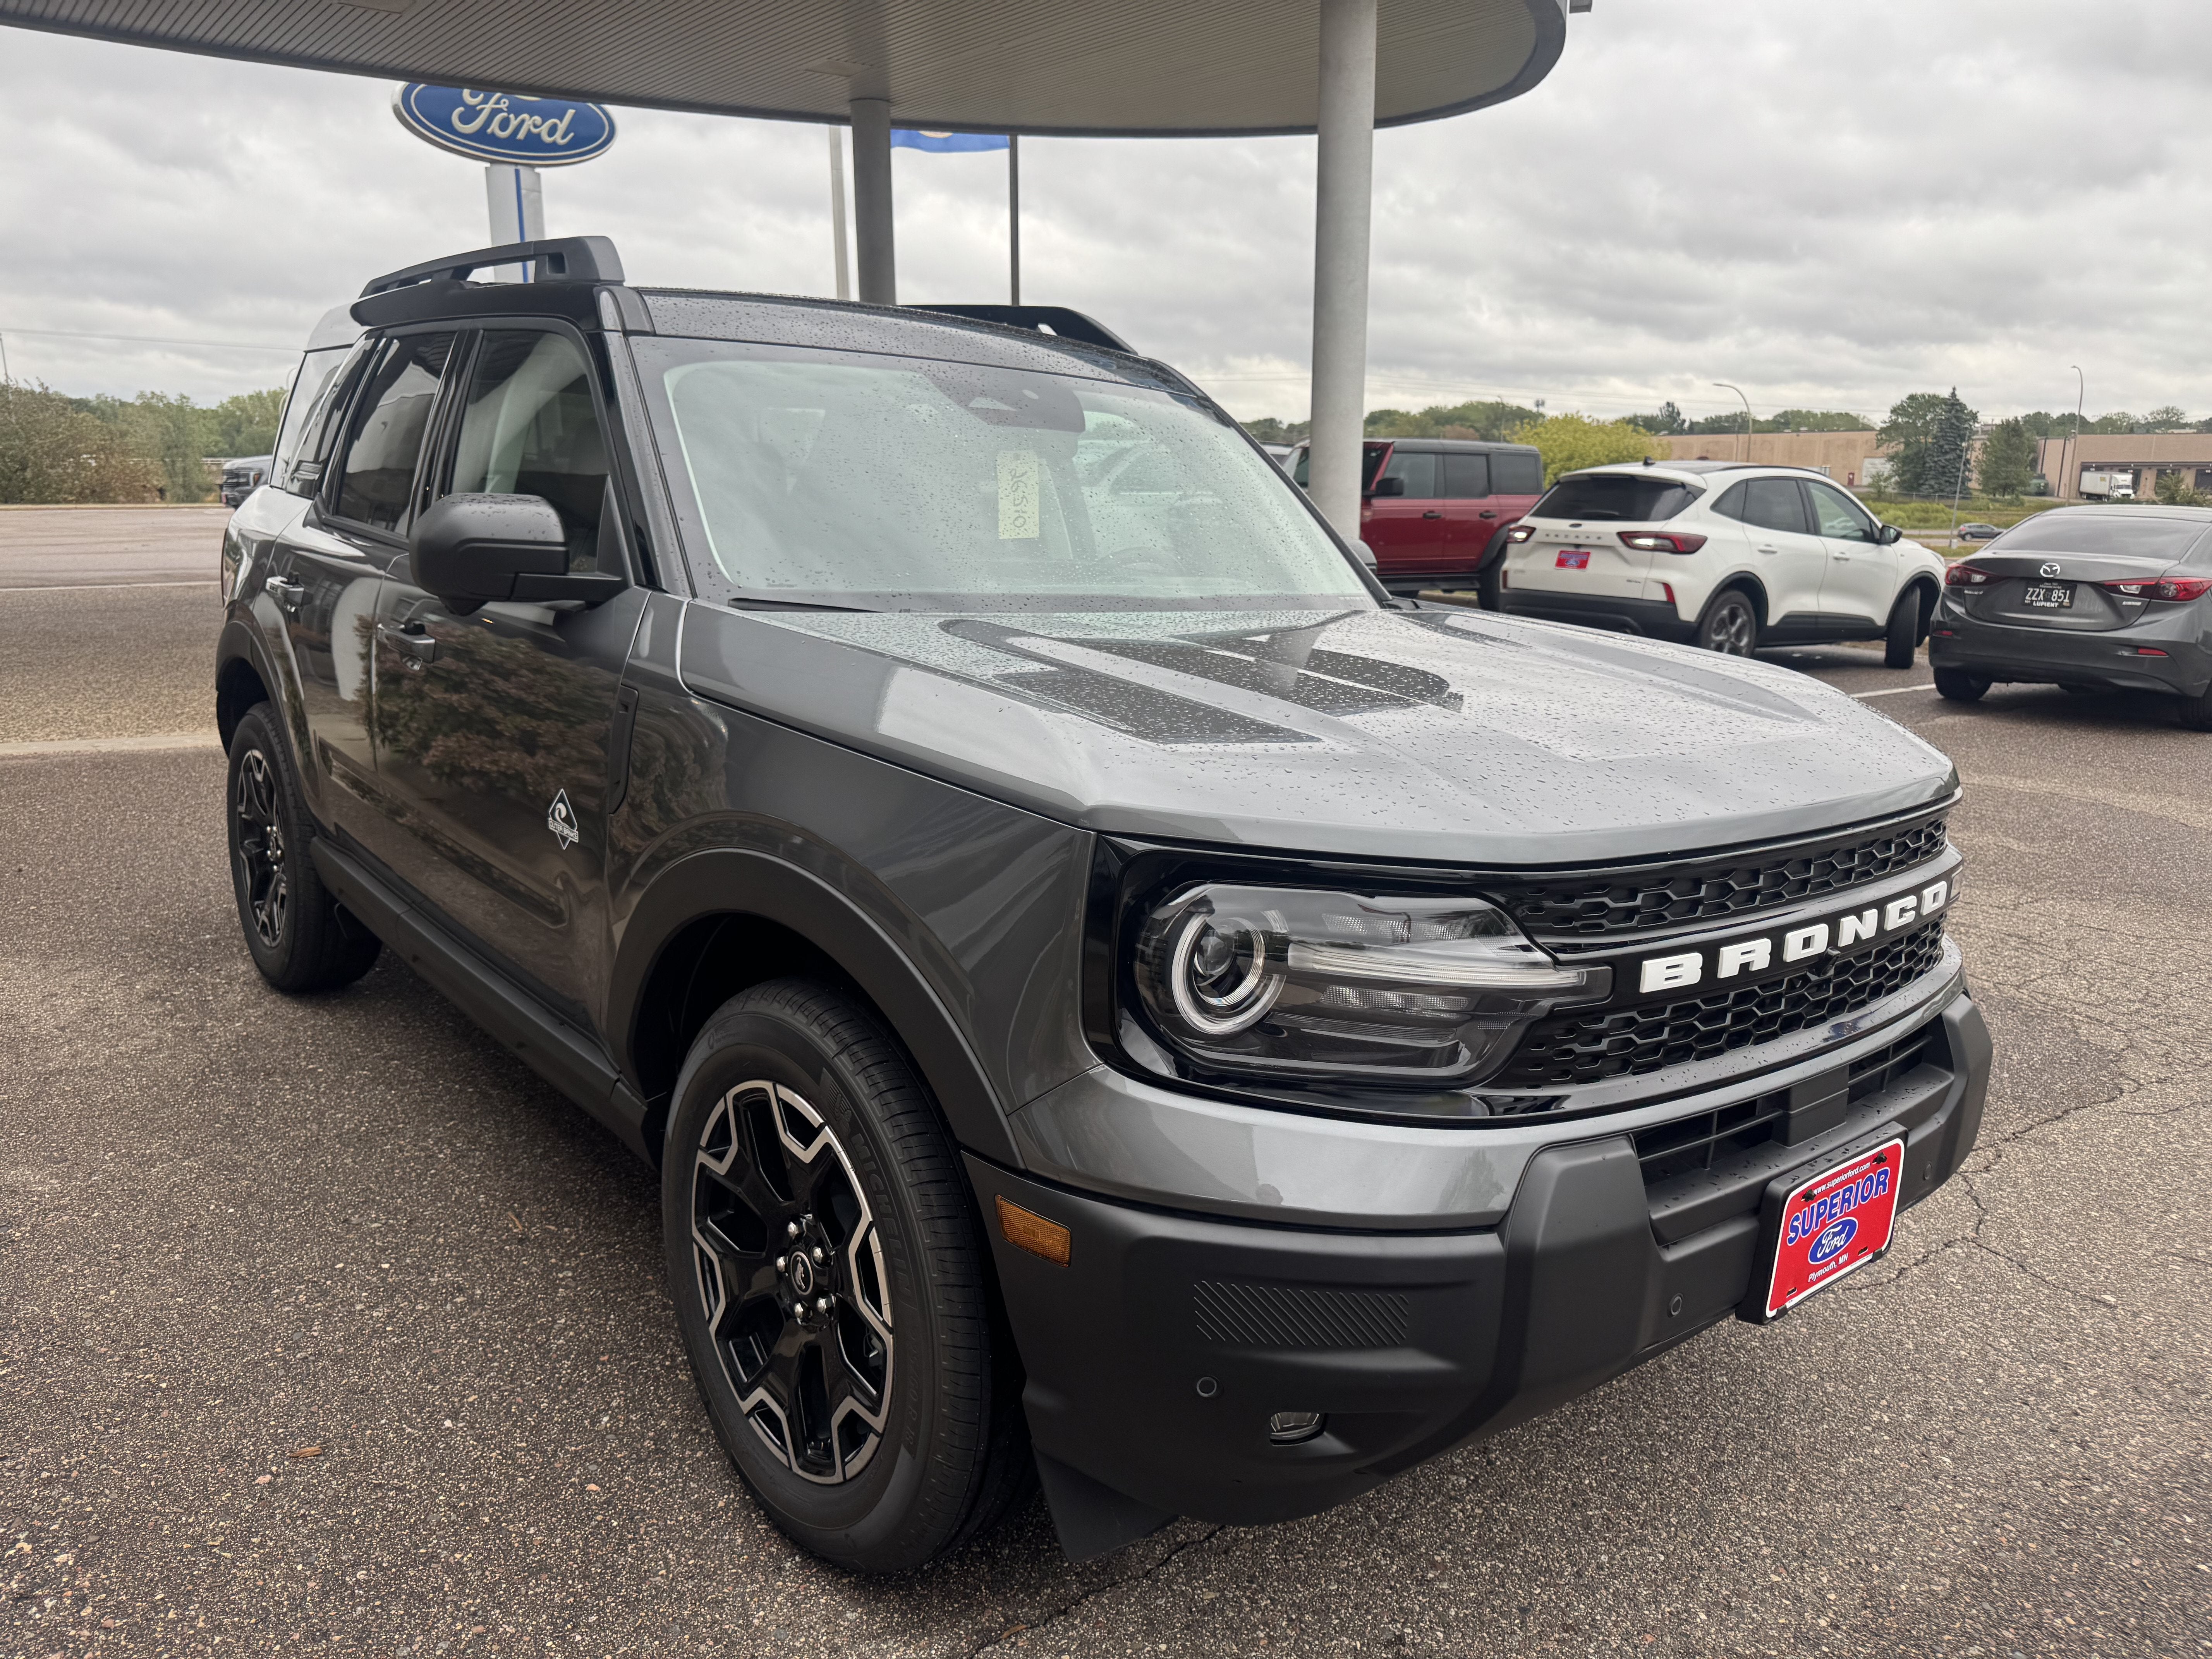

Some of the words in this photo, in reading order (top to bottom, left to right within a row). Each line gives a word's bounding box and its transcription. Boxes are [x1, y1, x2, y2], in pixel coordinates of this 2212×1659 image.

[452, 88, 576, 146] Ford
[2025, 587, 2046, 601] ZZX
[2051, 589, 2071, 603] 851
[550, 821, 563, 833] OUTER
[1640, 881, 1947, 993] BRONCO
[1813, 1162, 1871, 1195] www.superiorford.com
[851, 1133, 912, 1296] MICHELIN
[1787, 1167, 1890, 1246] SUPERIOR
[1817, 1224, 1849, 1258] Ford
[1808, 1261, 1837, 1283] Plymouth,
[1838, 1252, 1848, 1265] MN
